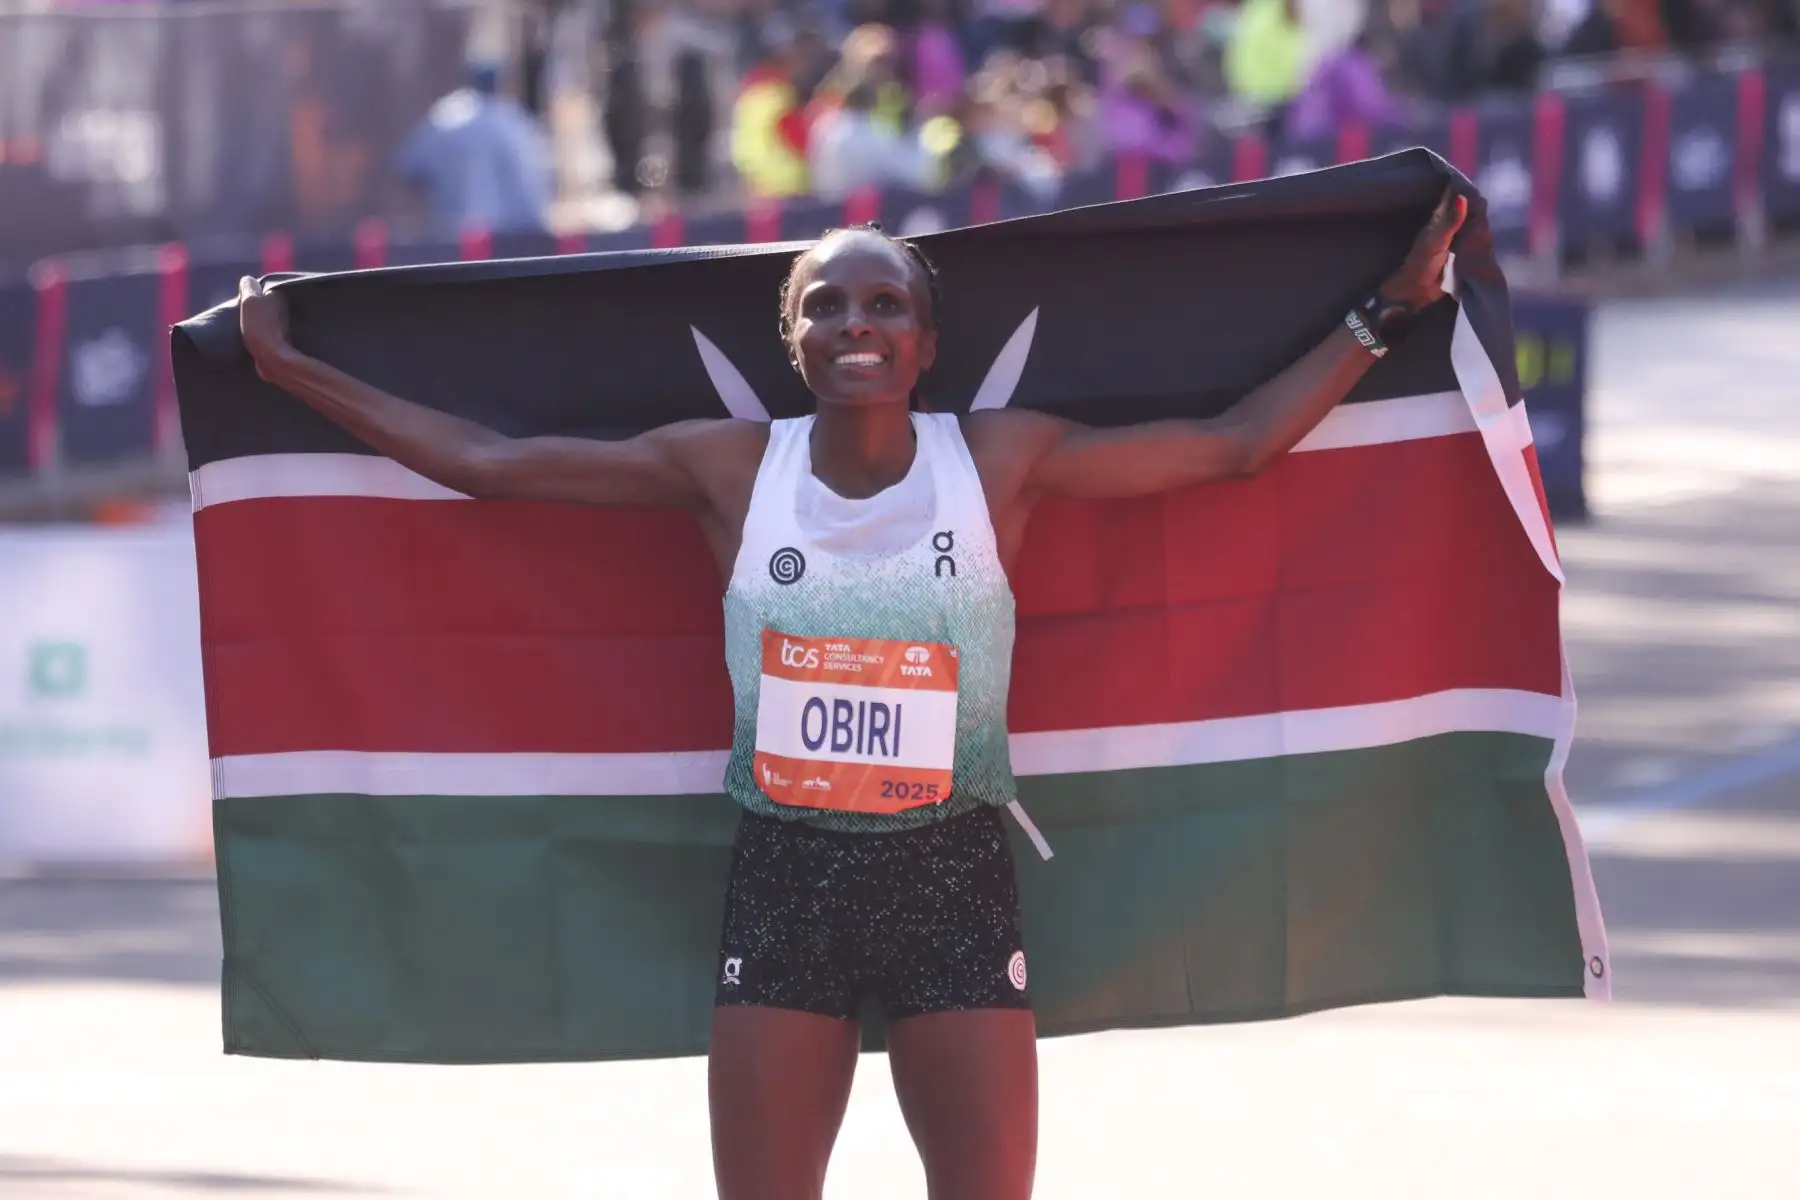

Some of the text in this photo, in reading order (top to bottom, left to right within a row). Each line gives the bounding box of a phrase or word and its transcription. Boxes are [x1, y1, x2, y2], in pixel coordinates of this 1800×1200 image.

[781, 638, 820, 669] tcs
[824, 643, 851, 653] TATA
[824, 652, 885, 665] CONSULTANCY
[823, 662, 862, 672] SERVICES
[900, 665, 933, 677] TATA
[801, 696, 902, 758] OBIRI
[881, 780, 939, 800] 2025
